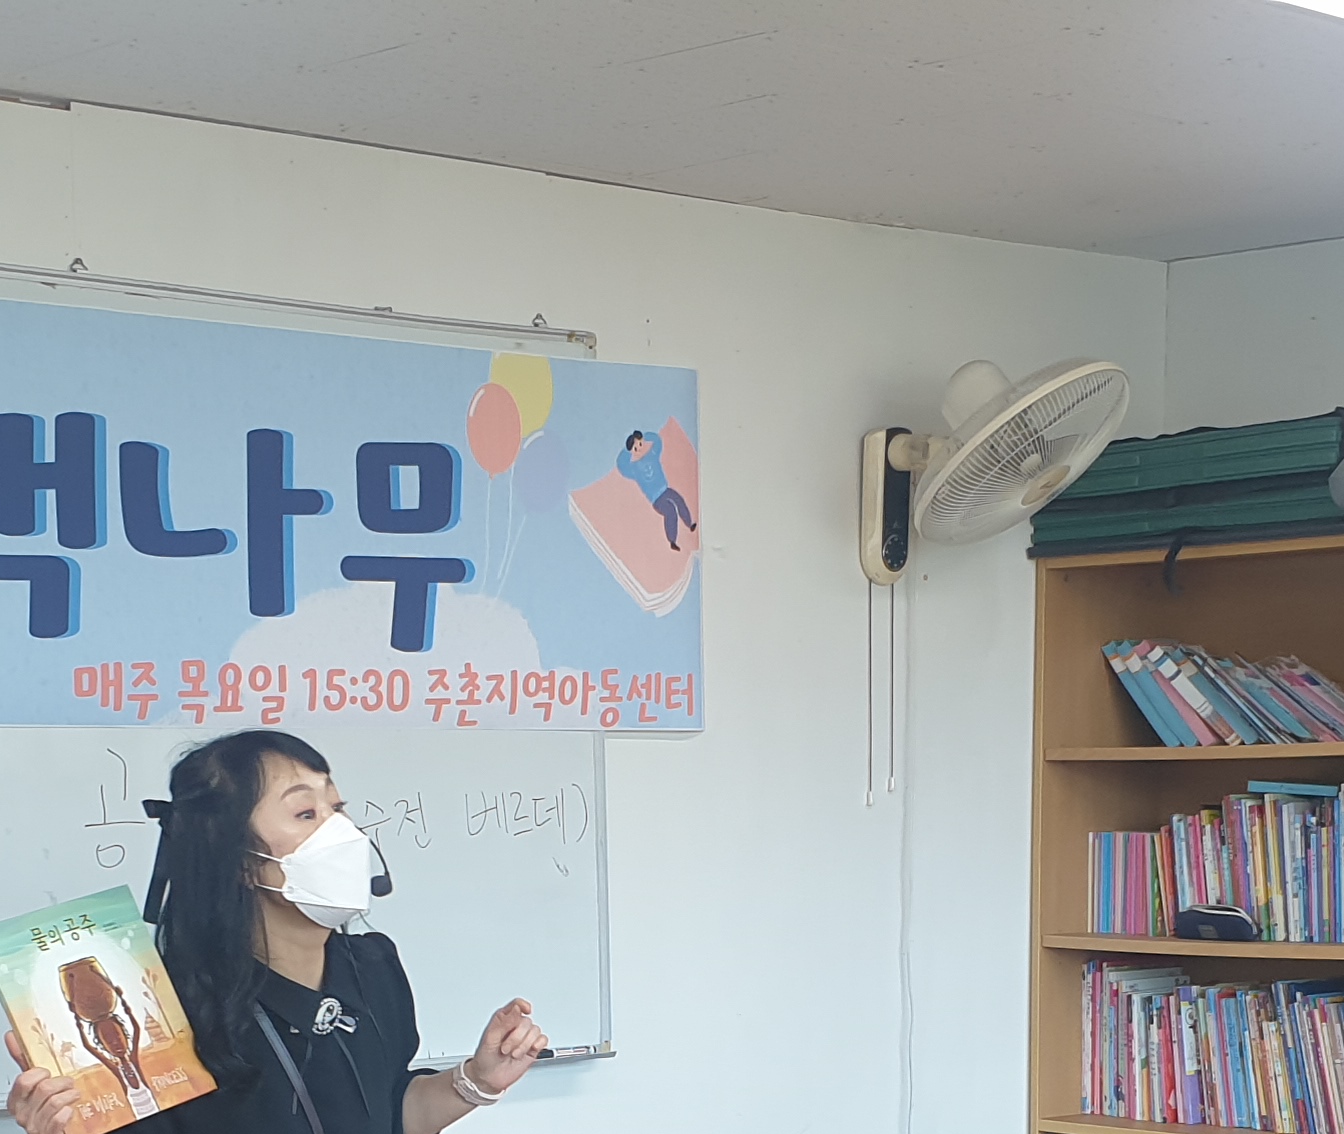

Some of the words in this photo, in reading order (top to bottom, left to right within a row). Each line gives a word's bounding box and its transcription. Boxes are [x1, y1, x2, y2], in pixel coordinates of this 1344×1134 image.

[73, 661, 160, 721] 매주
[177, 659, 290, 726] 목요일
[301, 668, 412, 713] 15:30
[424, 662, 696, 729] 주촌지역아동센터
[29, 924, 66, 952] 물의
[62, 913, 97, 941] 공주
